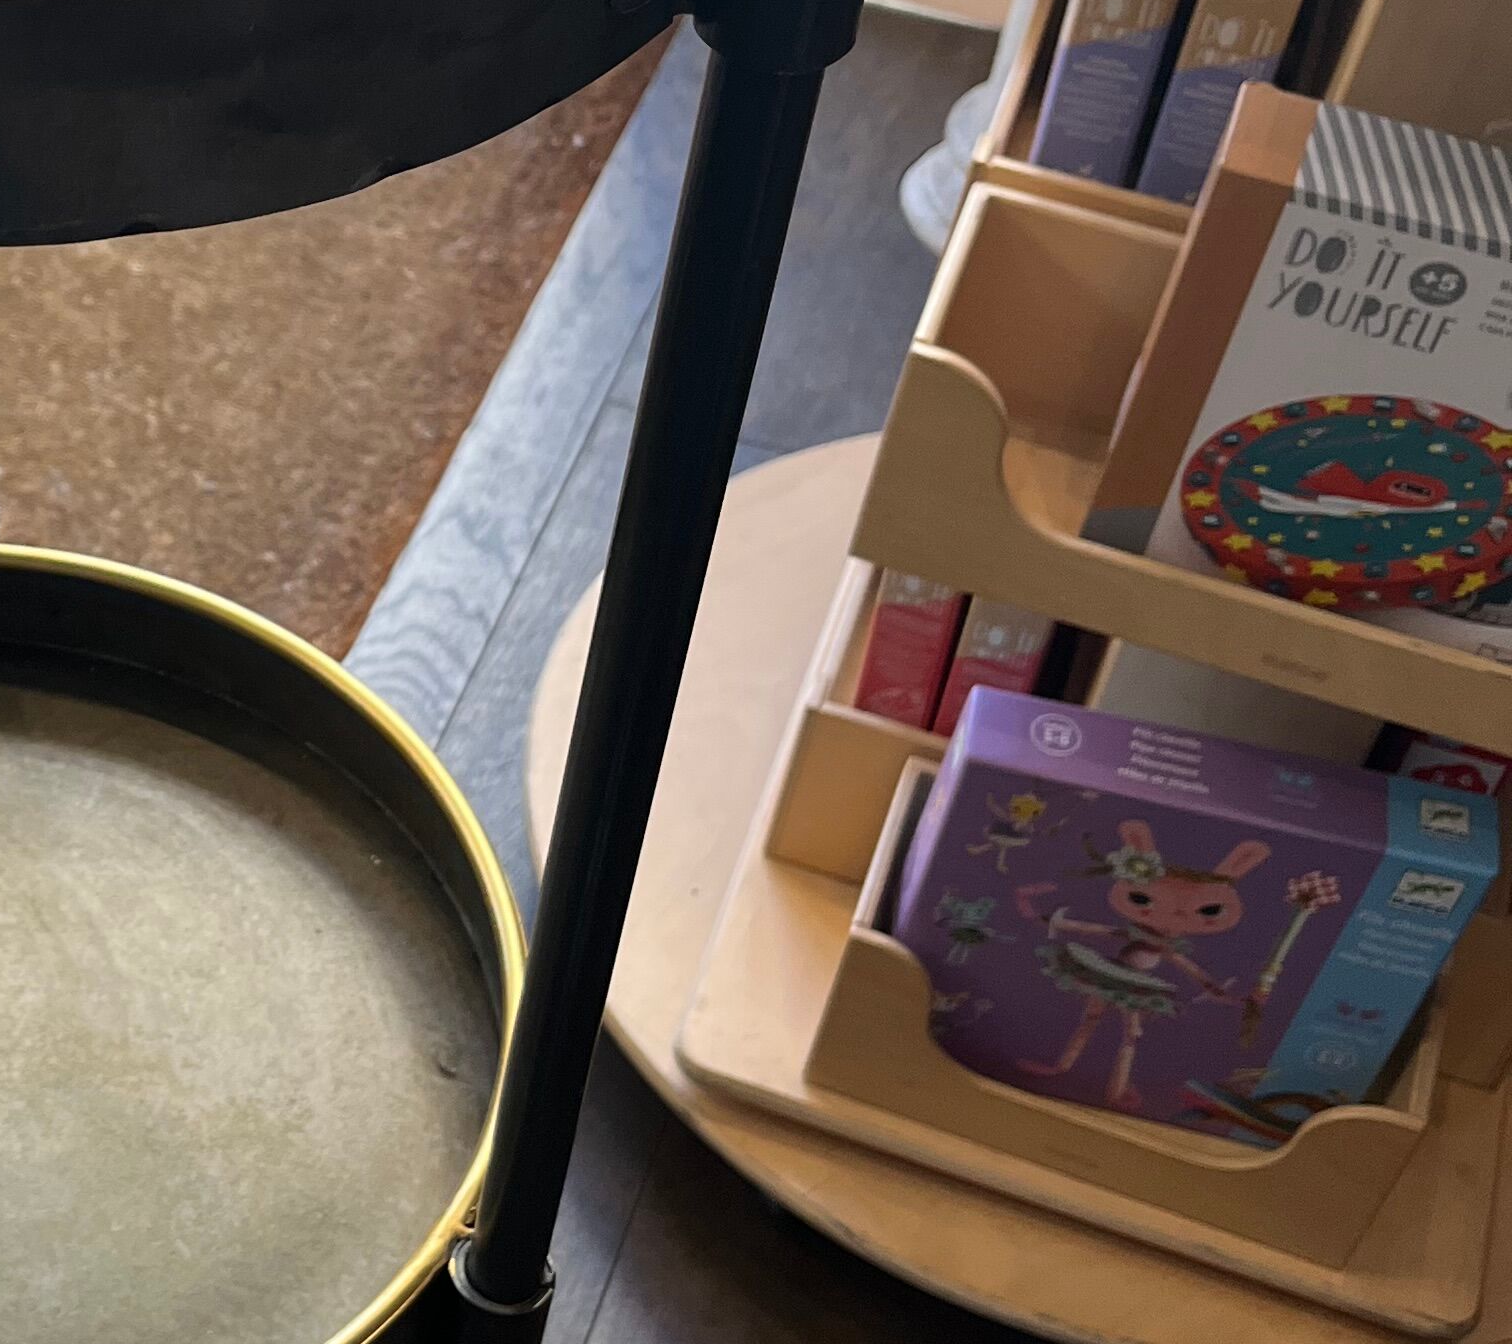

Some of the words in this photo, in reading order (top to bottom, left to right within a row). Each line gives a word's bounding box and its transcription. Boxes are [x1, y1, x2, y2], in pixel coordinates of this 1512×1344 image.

[1284, 227, 1348, 274] DO
[1365, 246, 1406, 290] IT
[1268, 270, 1459, 354] YOURSELF
